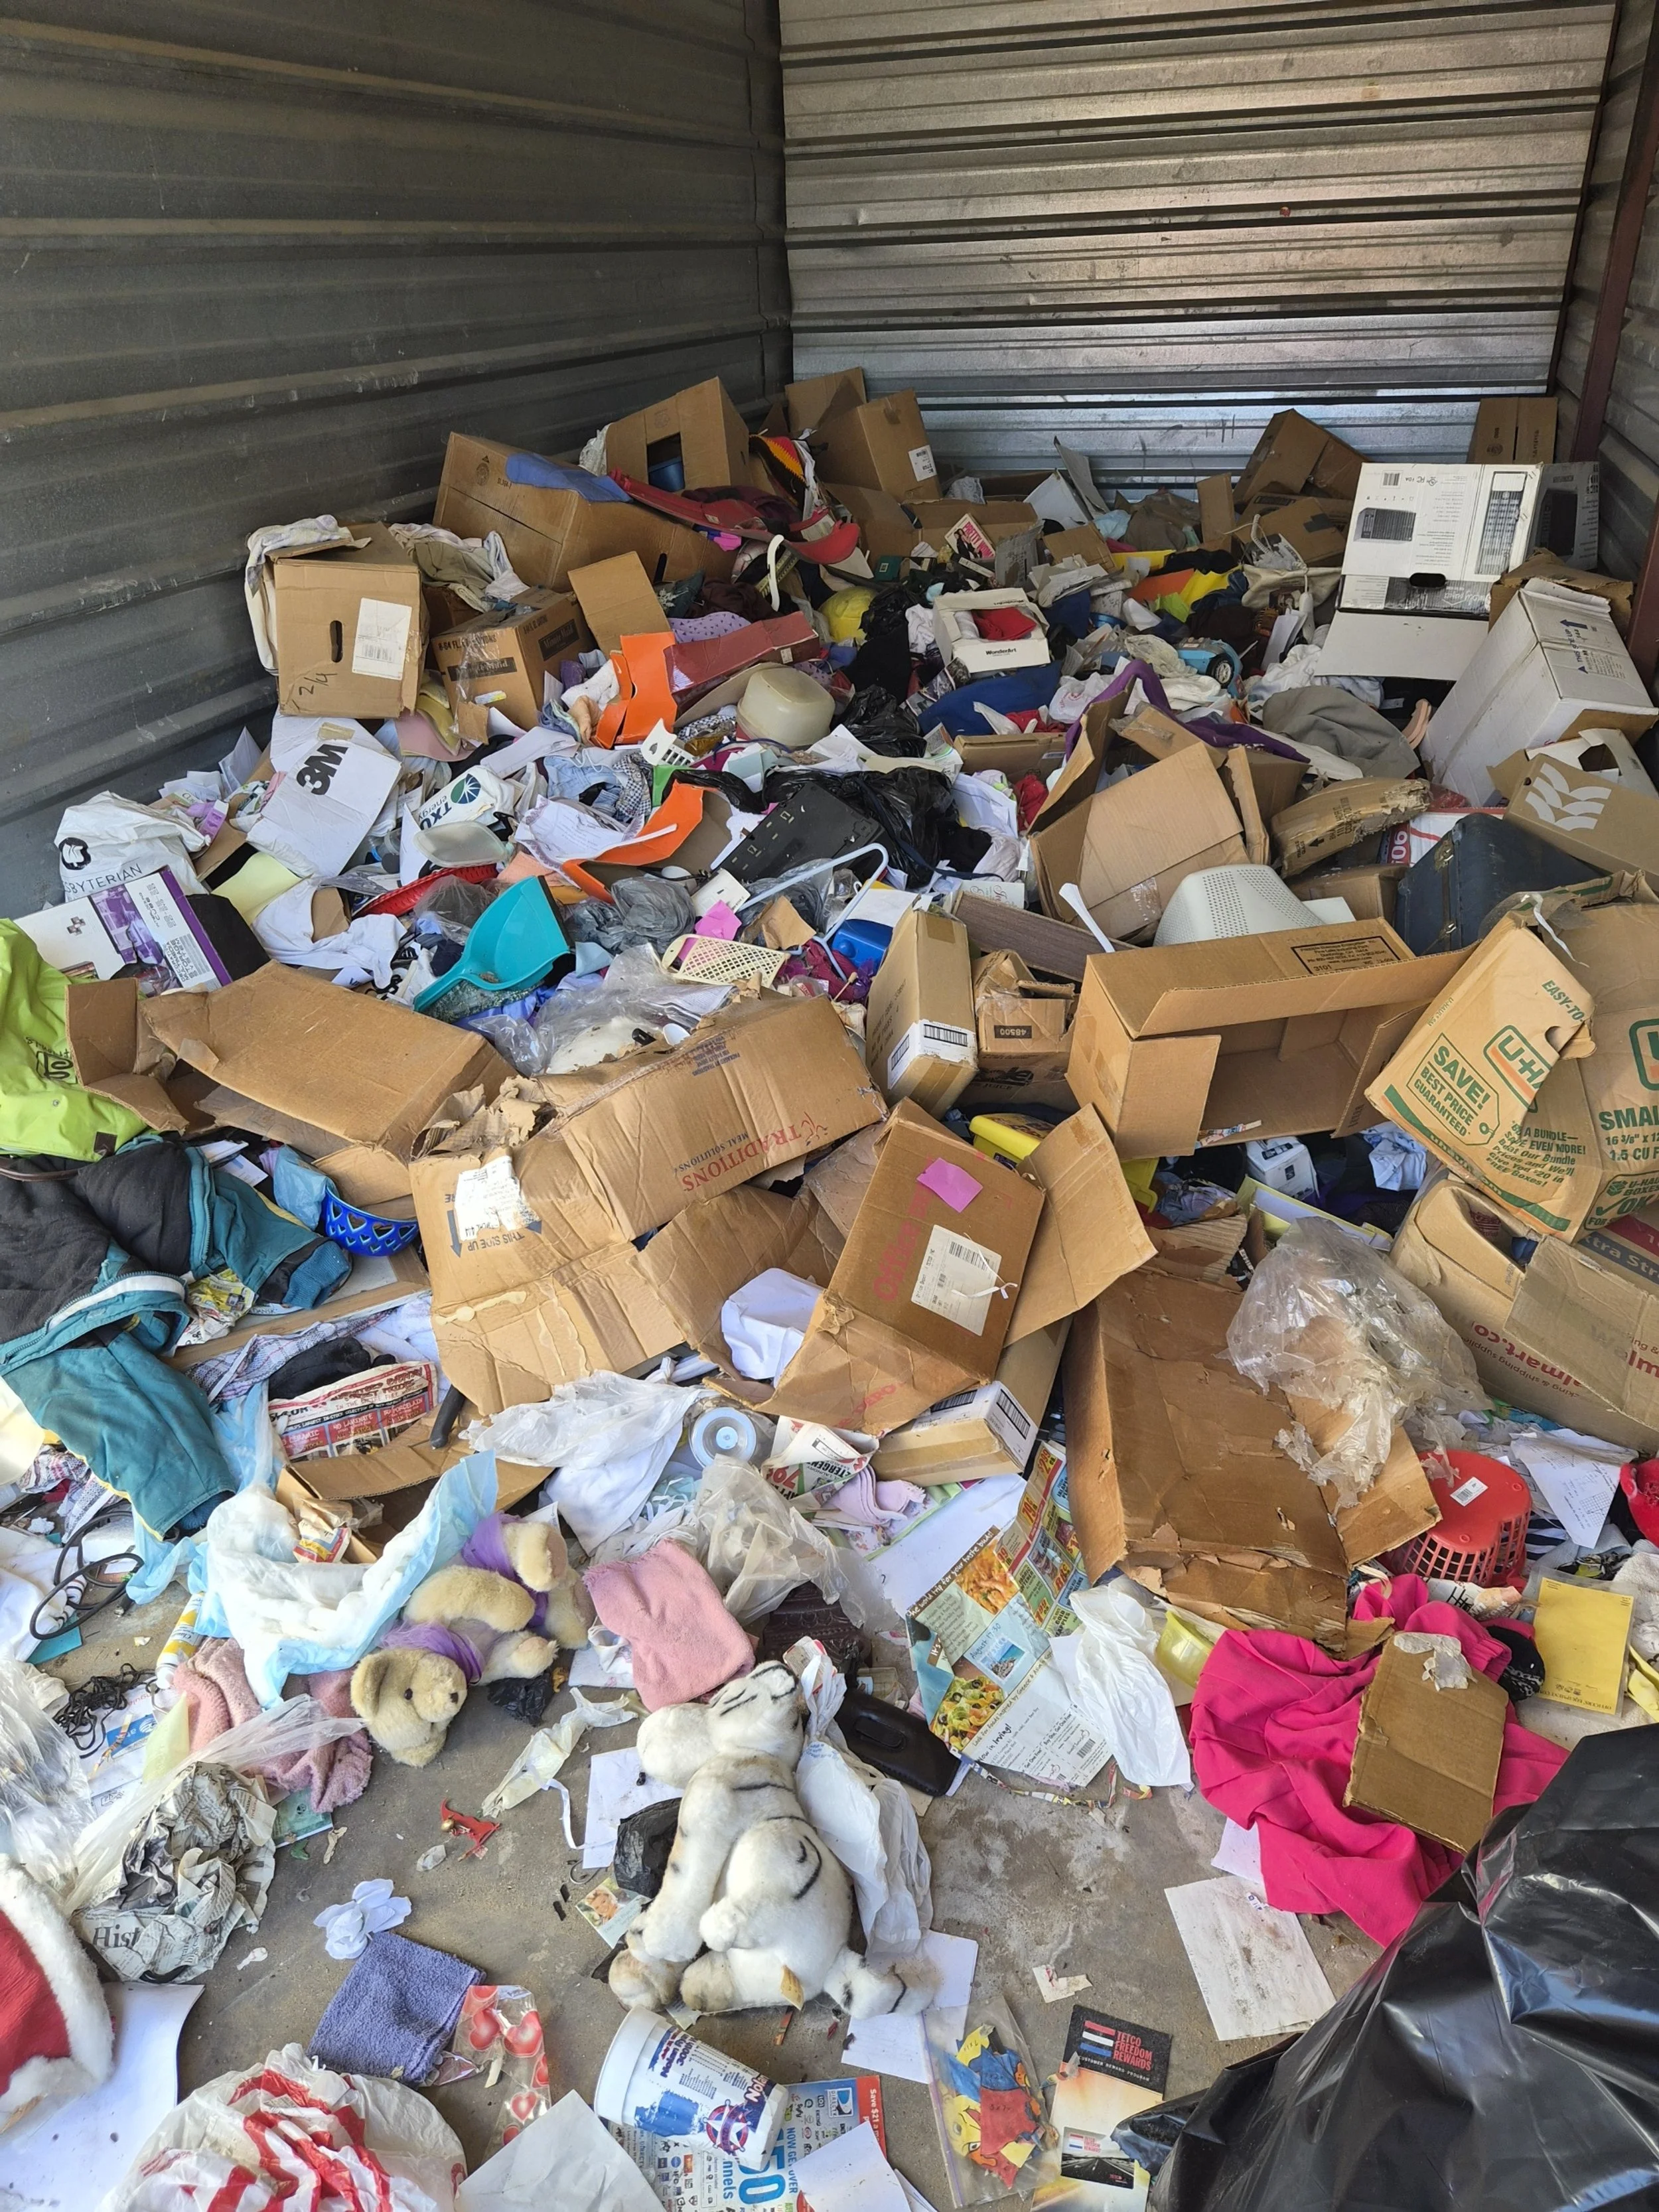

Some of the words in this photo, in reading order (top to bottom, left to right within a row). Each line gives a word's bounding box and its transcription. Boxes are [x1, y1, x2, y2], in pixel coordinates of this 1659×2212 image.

[295, 743, 348, 795] 3M
[418, 795, 447, 822] energy
[420, 801, 452, 830] TXU
[1433, 1045, 1491, 1110] SAVE!
[1420, 1066, 1446, 1094] BEST
[1443, 1092, 1475, 1127] PRICE
[729, 1131, 749, 1147] MEAL
[1524, 1127, 1532, 1137] A
[1605, 1136, 1619, 1146] 16
[679, 1142, 726, 1173] SOLUTIONS
[682, 1124, 802, 1192] TRADITIONS
[1489, 1151, 1510, 1166] Give
[1492, 1145, 1523, 1163] Prices
[1525, 1160, 1548, 1169] and
[1520, 1150, 1541, 1159] Our
[1543, 1154, 1576, 1165] Bundle
[1529, 1141, 1553, 1152] EVEN
[1555, 1143, 1586, 1155] MORE!
[1609, 1149, 1628, 1161] 1.5
[1632, 1147, 1650, 1161] CU
[1486, 1157, 1511, 1173] FREE
[1511, 1169, 1548, 1187] Boxes!
[467, 1242, 479, 1252] UP
[504, 1232, 525, 1244] THIS
[1498, 1356, 1540, 1385] shipping
[344, 1414, 374, 1428] LAMINATE
[919, 1592, 934, 1611] world
[932, 1583, 944, 1598] trip
[940, 1574, 952, 1587] for
[950, 1560, 965, 1580] your
[962, 1544, 981, 1564] taste
[968, 1635, 990, 1659] August
[995, 1723, 1013, 1745] Irving!
[1117, 2030, 1141, 2047] TETCO
[1114, 2050, 1152, 2071] REWARDS
[1115, 2040, 1153, 2060] FREEDOM
[786, 2126, 796, 2148] NOW
